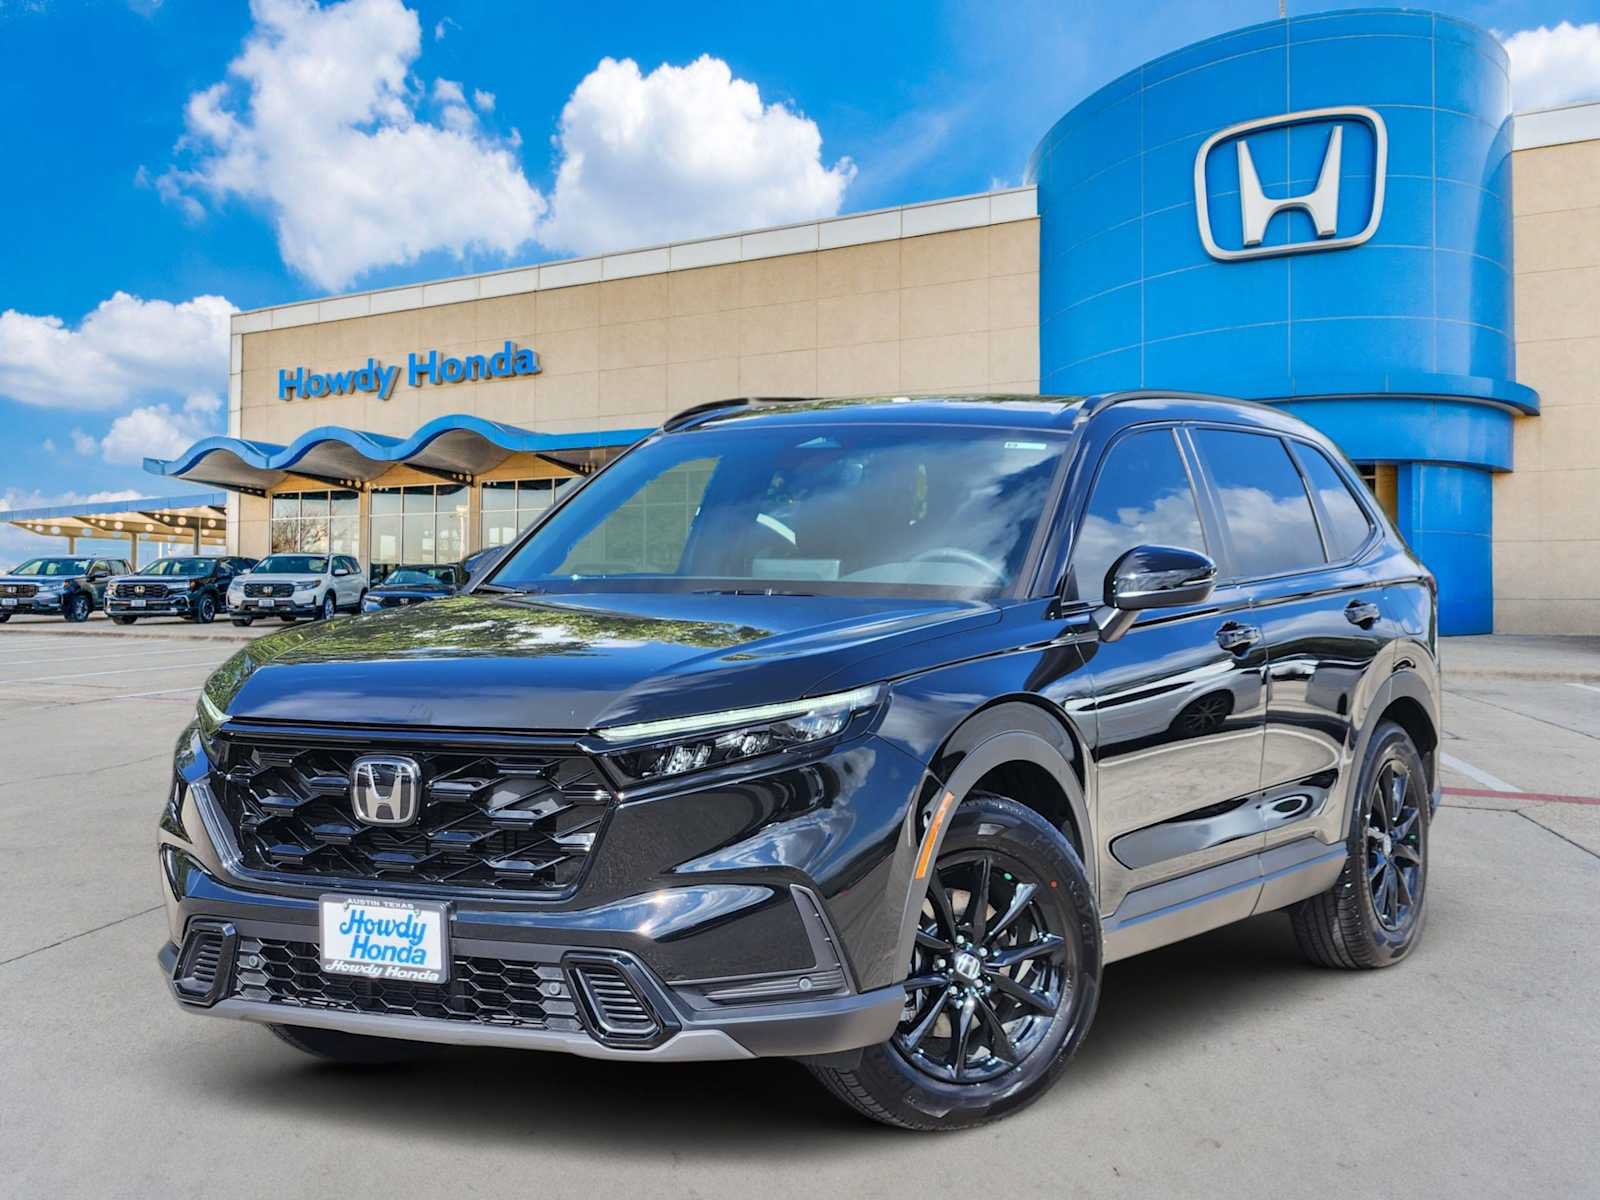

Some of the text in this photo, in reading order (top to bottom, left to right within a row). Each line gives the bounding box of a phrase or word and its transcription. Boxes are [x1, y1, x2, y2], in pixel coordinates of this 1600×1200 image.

[278, 340, 541, 400] Howdy Honda
[347, 898, 414, 909] AUSTIN TEXAS
[339, 909, 426, 945] Howdy
[350, 934, 427, 965] Honda
[325, 960, 439, 981] Howdy Honda
